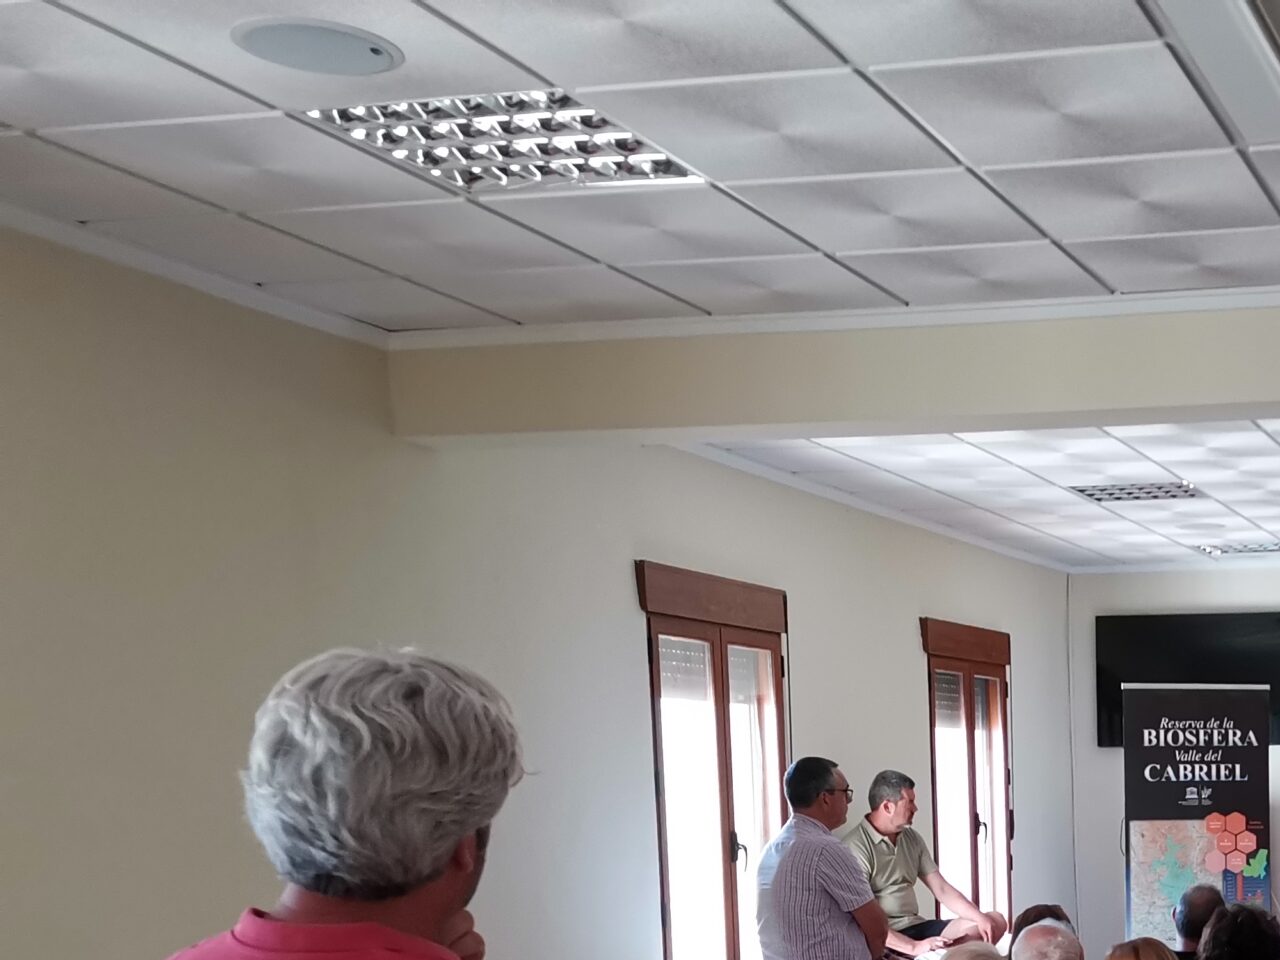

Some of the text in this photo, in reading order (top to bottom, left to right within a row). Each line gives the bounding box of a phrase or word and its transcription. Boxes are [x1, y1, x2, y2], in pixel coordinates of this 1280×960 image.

[1159, 717, 1234, 729] Reserva de la
[1175, 749, 1222, 762] Valle del
[1144, 763, 1249, 782] CABRIEL
